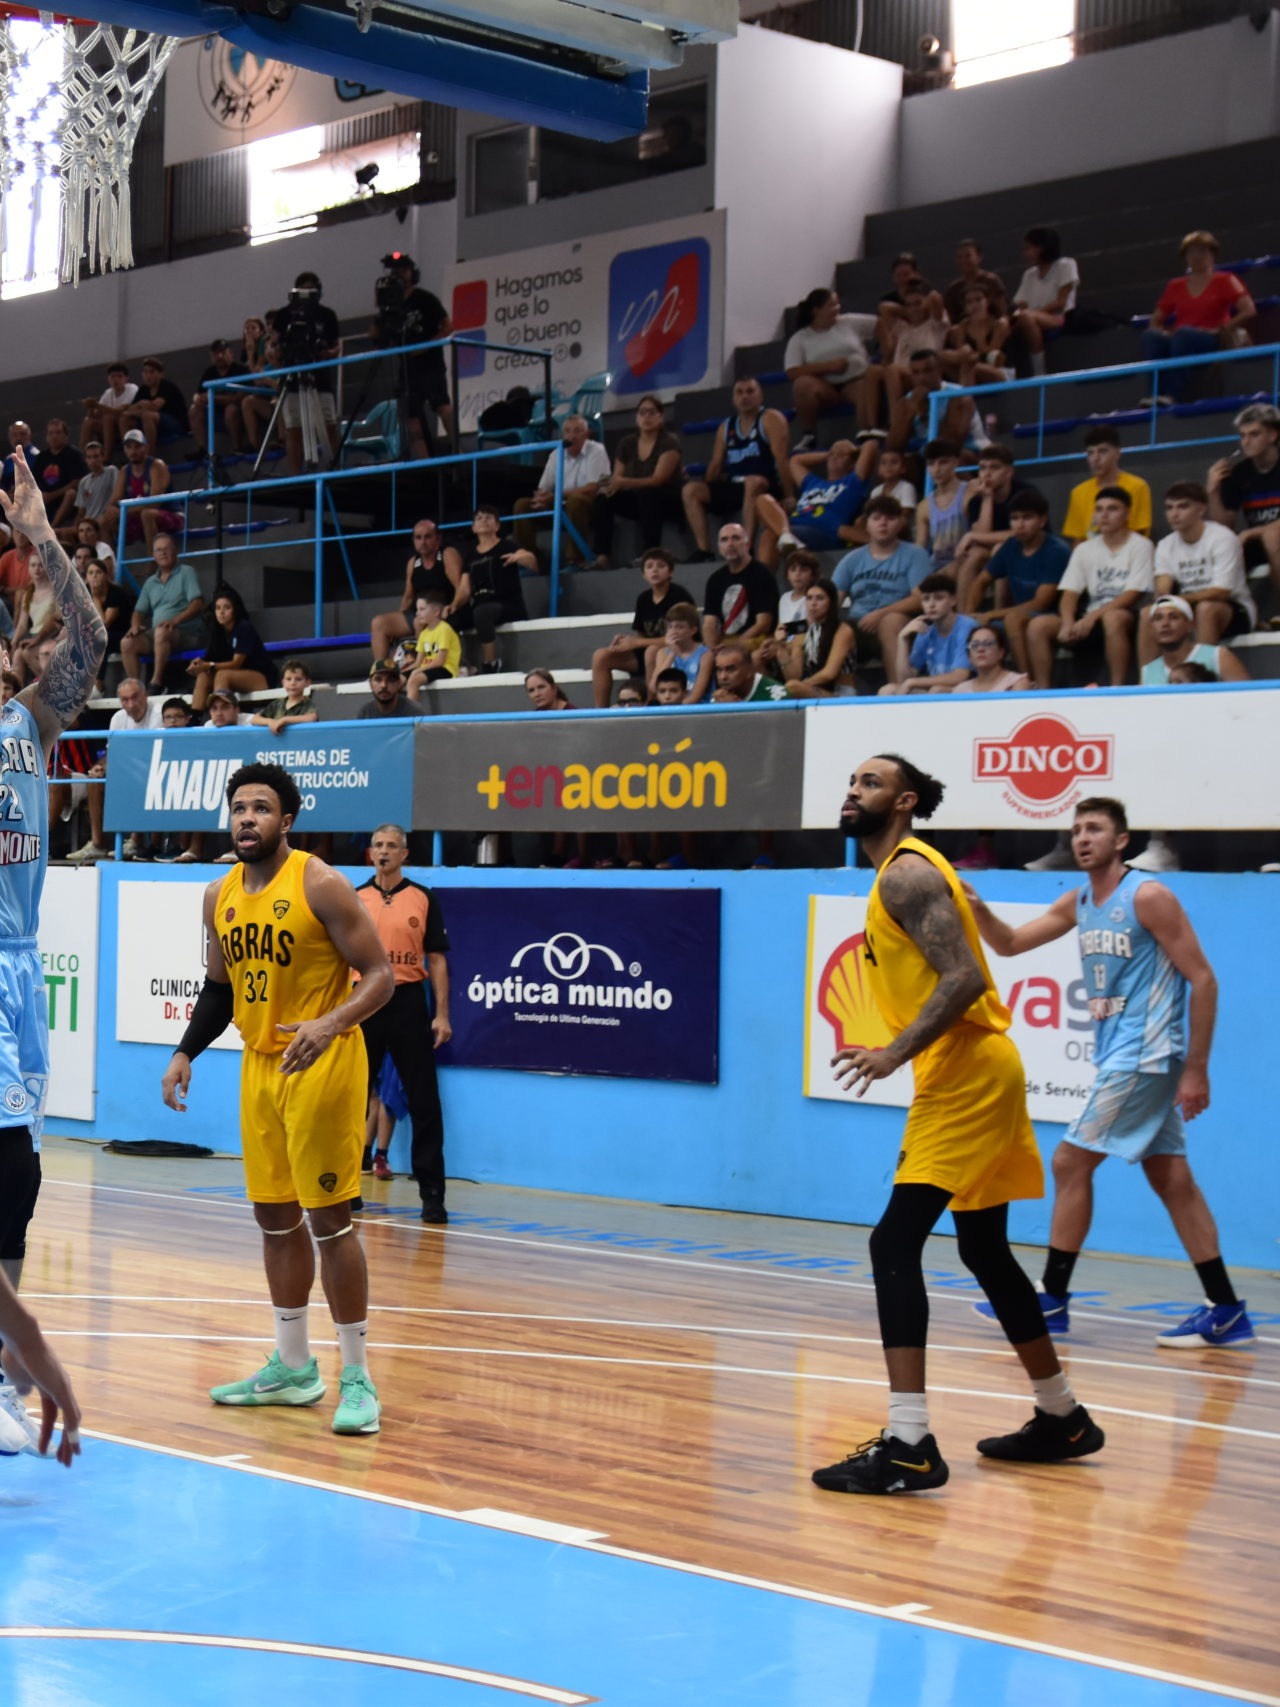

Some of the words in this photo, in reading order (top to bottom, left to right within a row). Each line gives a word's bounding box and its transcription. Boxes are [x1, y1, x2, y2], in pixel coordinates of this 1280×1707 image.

[495, 265, 583, 298] Hagamos
[495, 301, 530, 325] que
[533, 295, 550, 317] lo
[523, 319, 582, 343] bueno
[256, 750, 326, 767] SISTEMAS
[330, 748, 350, 766] DE
[981, 743, 1104, 775] DINCO
[287, 767, 369, 788] TRUCCIÓN
[220, 923, 295, 967] OBRAS
[151, 978, 200, 998] CLINICA
[244, 969, 269, 1004] 32
[468, 974, 559, 1009] óptica
[568, 980, 673, 1011] mundo
[164, 1002, 181, 1021] Dr.
[550, 1014, 558, 1023] de
[1044, 1081, 1093, 1099] Servic
